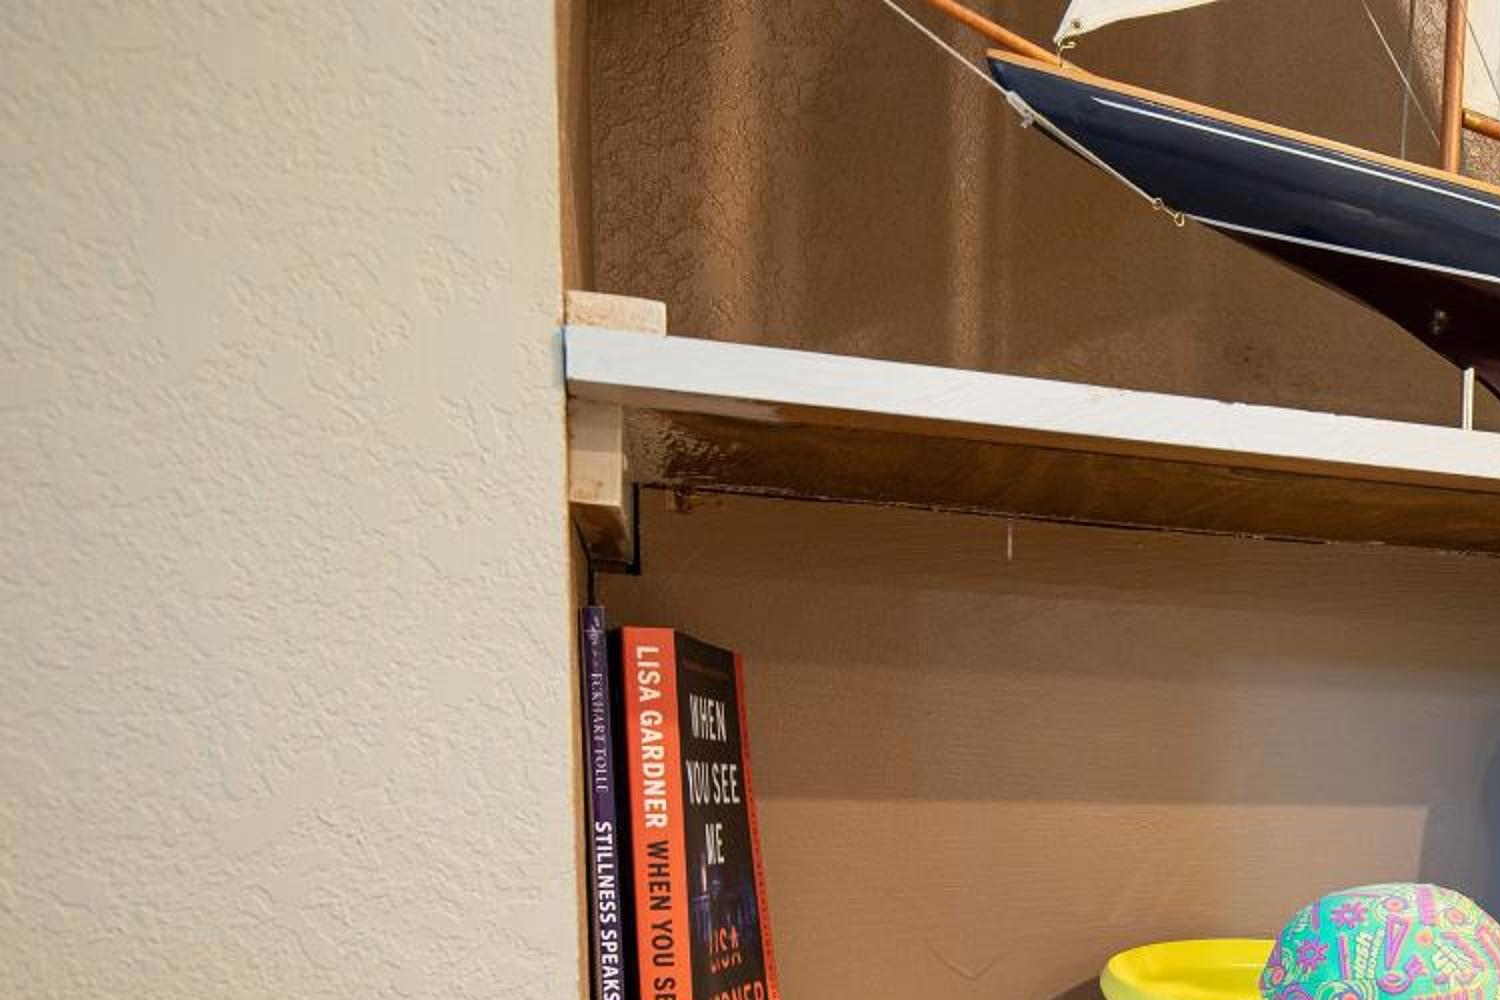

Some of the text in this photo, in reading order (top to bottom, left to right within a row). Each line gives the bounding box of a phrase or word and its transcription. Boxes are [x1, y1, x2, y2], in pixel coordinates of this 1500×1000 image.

[591, 672, 606, 744] ECKHART
[689, 693, 727, 743] WHEN
[635, 645, 668, 830] LISA GARDNER
[594, 745, 609, 794] TOLLE
[685, 759, 741, 805] YOU SEE
[704, 822, 726, 865] ME
[594, 821, 618, 926] STILLNESS
[646, 840, 674, 915] WHEN
[650, 918, 676, 968] YOU
[705, 925, 741, 973] LISA
